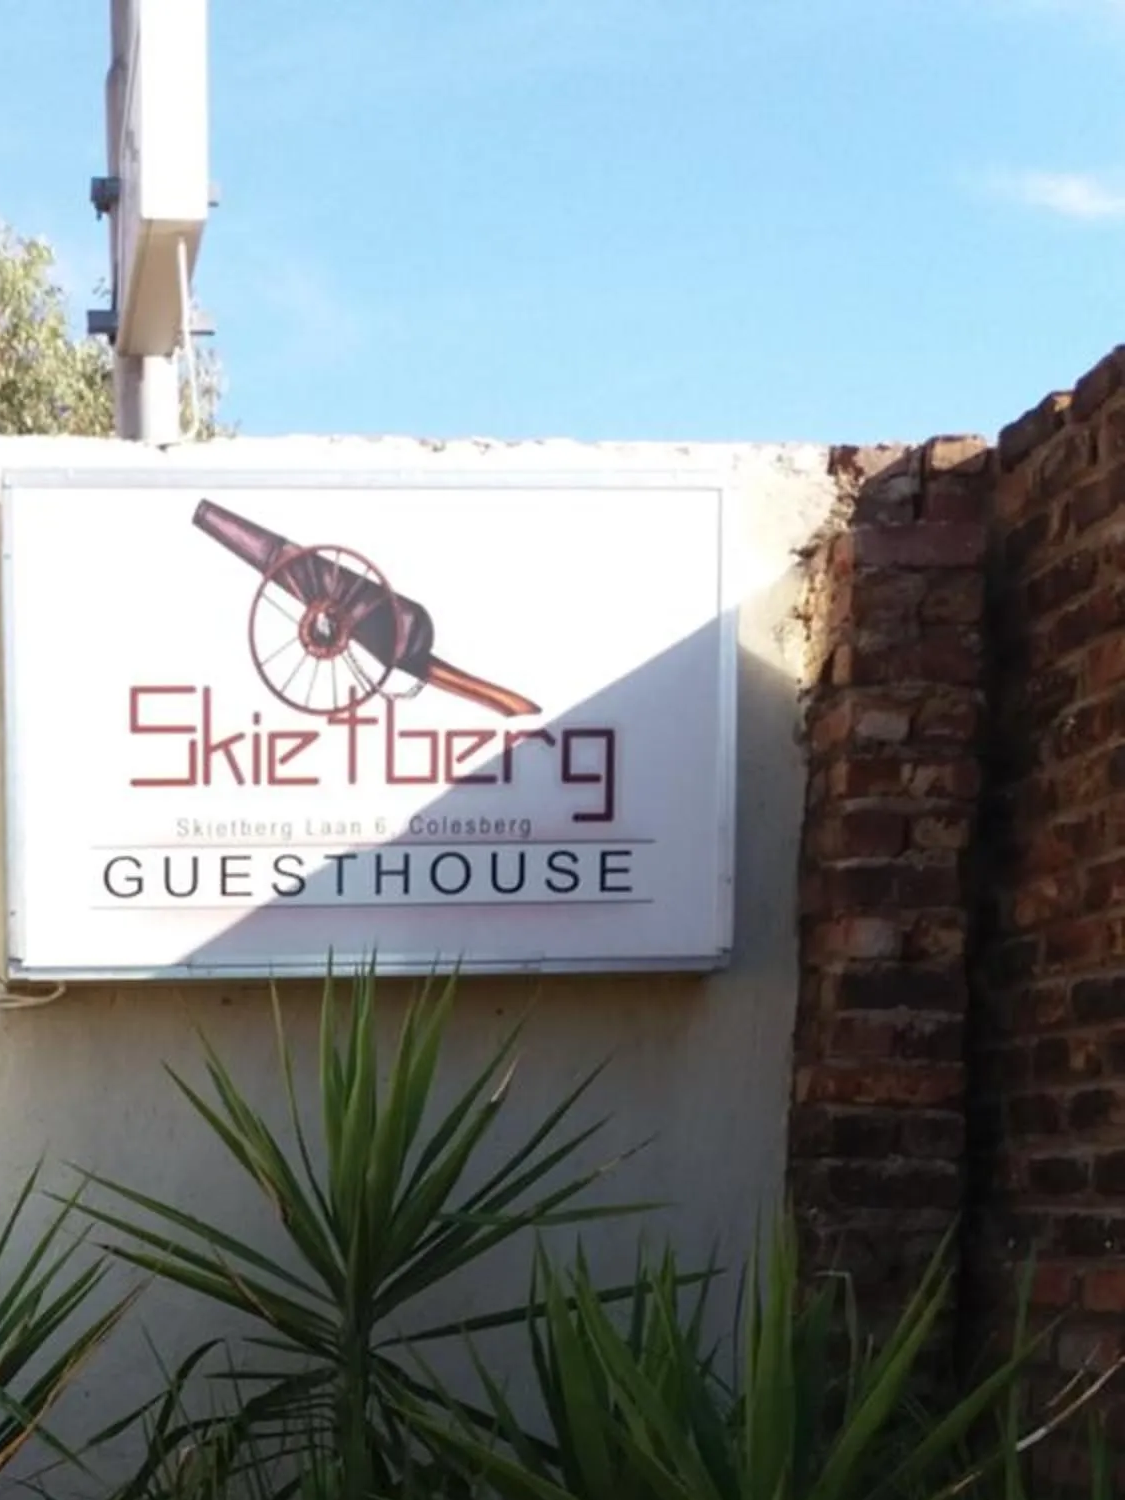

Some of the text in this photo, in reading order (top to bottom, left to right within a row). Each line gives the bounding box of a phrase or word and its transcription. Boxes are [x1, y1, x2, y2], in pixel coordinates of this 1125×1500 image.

[129, 685, 615, 822] Skietberg
[175, 817, 293, 840] Skietberg
[305, 816, 363, 837] Laan
[408, 814, 533, 837] Colesberg
[102, 849, 634, 898] GUESTHOUSE
